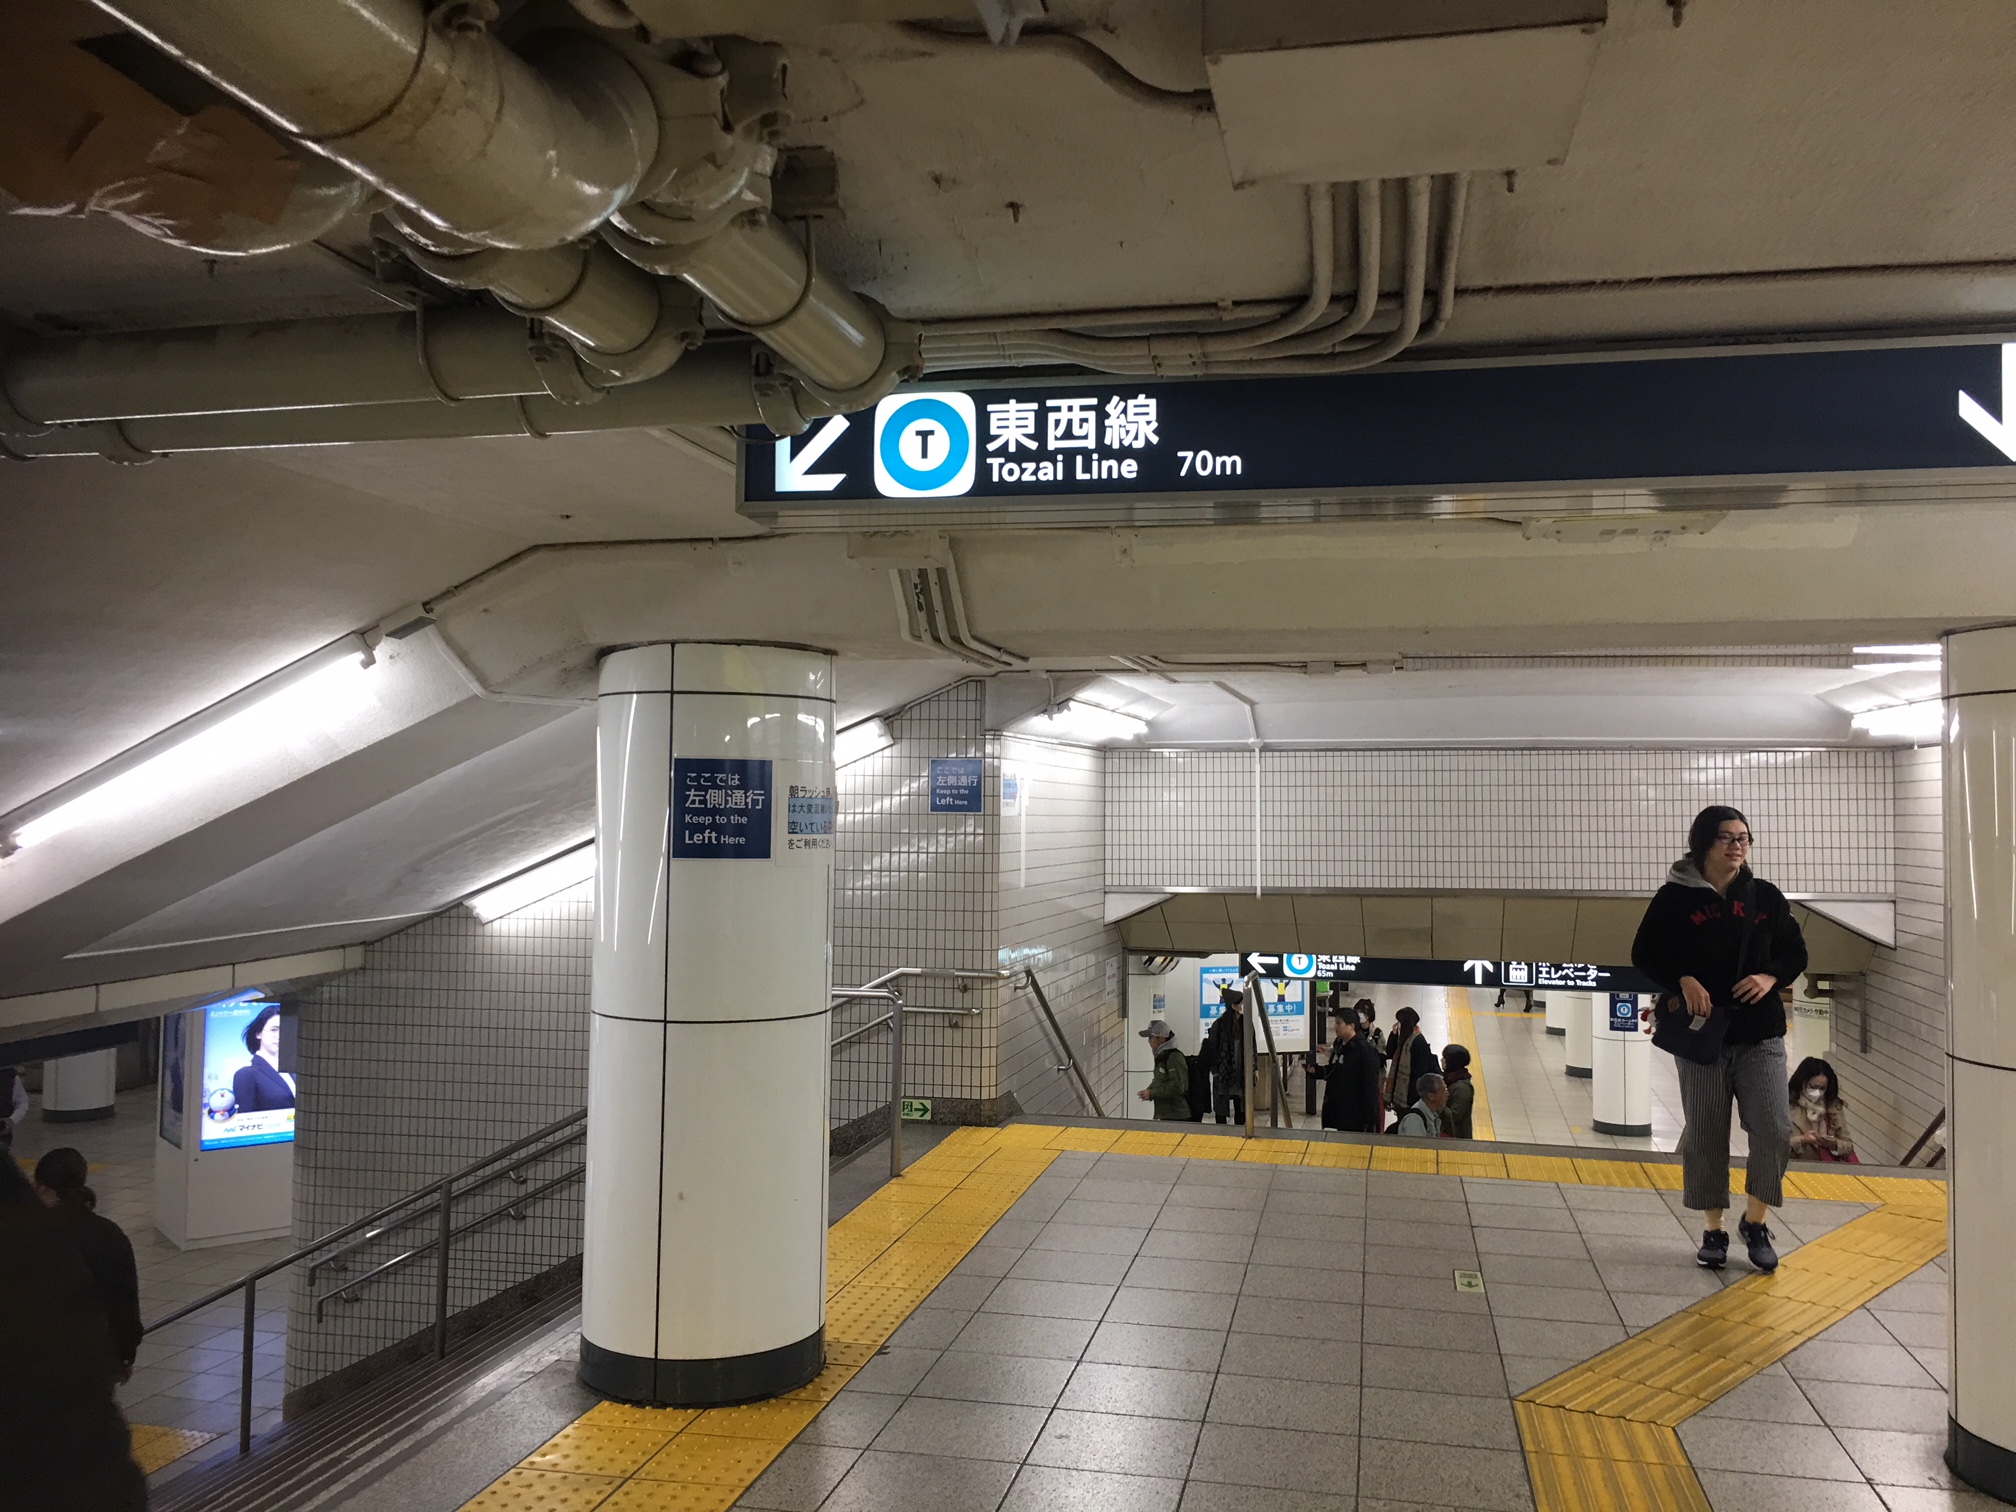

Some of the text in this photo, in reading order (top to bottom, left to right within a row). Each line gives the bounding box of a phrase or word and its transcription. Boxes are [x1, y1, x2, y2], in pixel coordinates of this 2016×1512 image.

[985, 394, 1160, 452] 東西線
[915, 430, 935, 459] T
[986, 450, 1242, 482] Tozai Line 70m
[686, 772, 741, 786] ここでは
[936, 775, 978, 786] 左側通行
[684, 789, 765, 810] 左側通行
[936, 797, 953, 805] Left
[684, 813, 748, 827] Keep to the
[684, 829, 746, 845] Left Here
[1317, 962, 1356, 971] Tozai Line
[1538, 966, 1611, 980] エレベーター
[1576, 979, 1597, 987] Tracks
[239, 1123, 263, 1131] マイナビ
